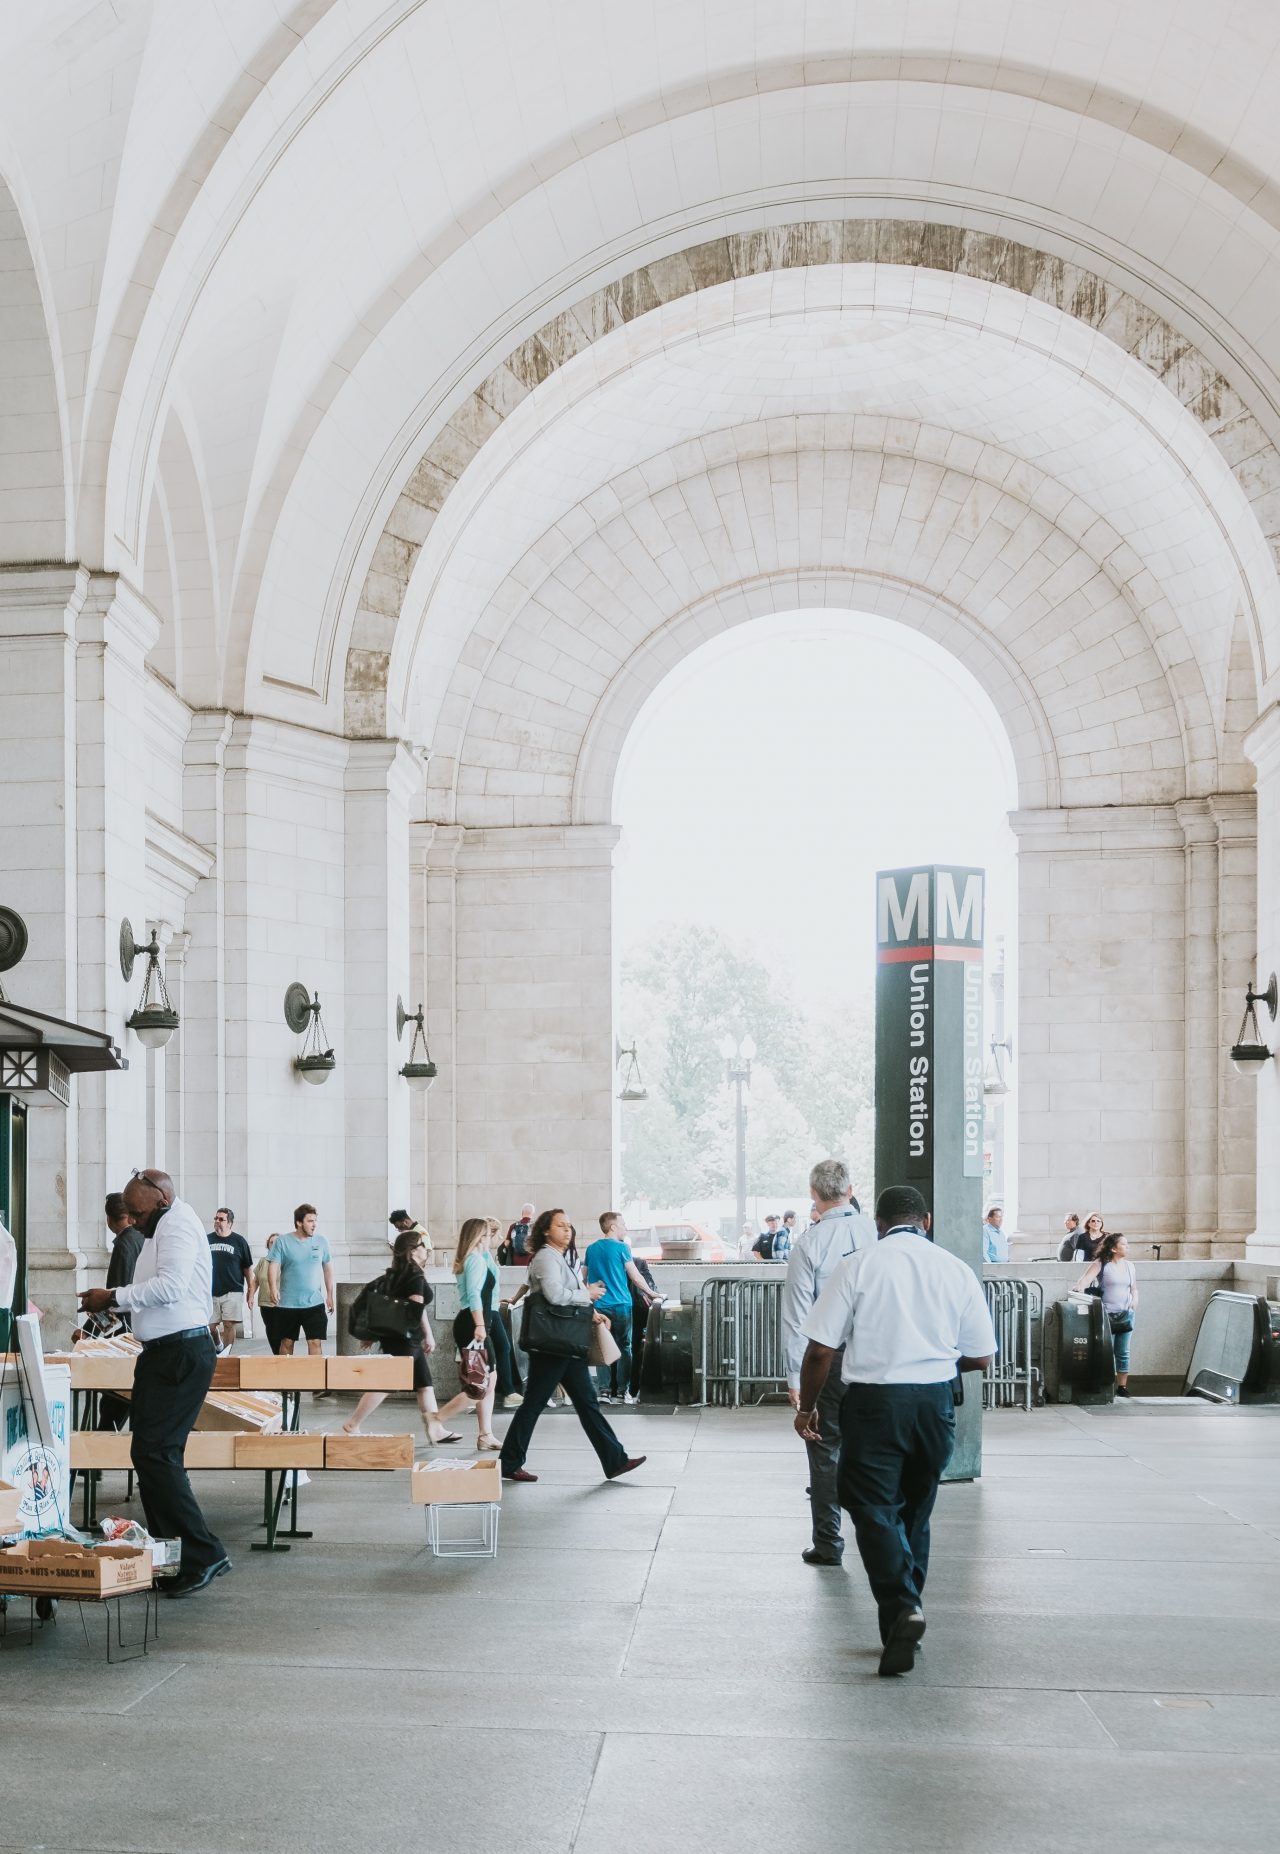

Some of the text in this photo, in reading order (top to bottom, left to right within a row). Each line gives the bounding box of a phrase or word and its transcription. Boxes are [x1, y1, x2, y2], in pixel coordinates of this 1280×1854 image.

[878, 873, 929, 943] M
[936, 871, 983, 941] M
[909, 963, 929, 1156] Union Station
[965, 964, 982, 1156] Union Station
[0, 1565, 24, 1575] FRUITS
[30, 1567, 49, 1577] NUTS
[55, 1568, 81, 1578] SNACK
[81, 1569, 95, 1579] MIX
